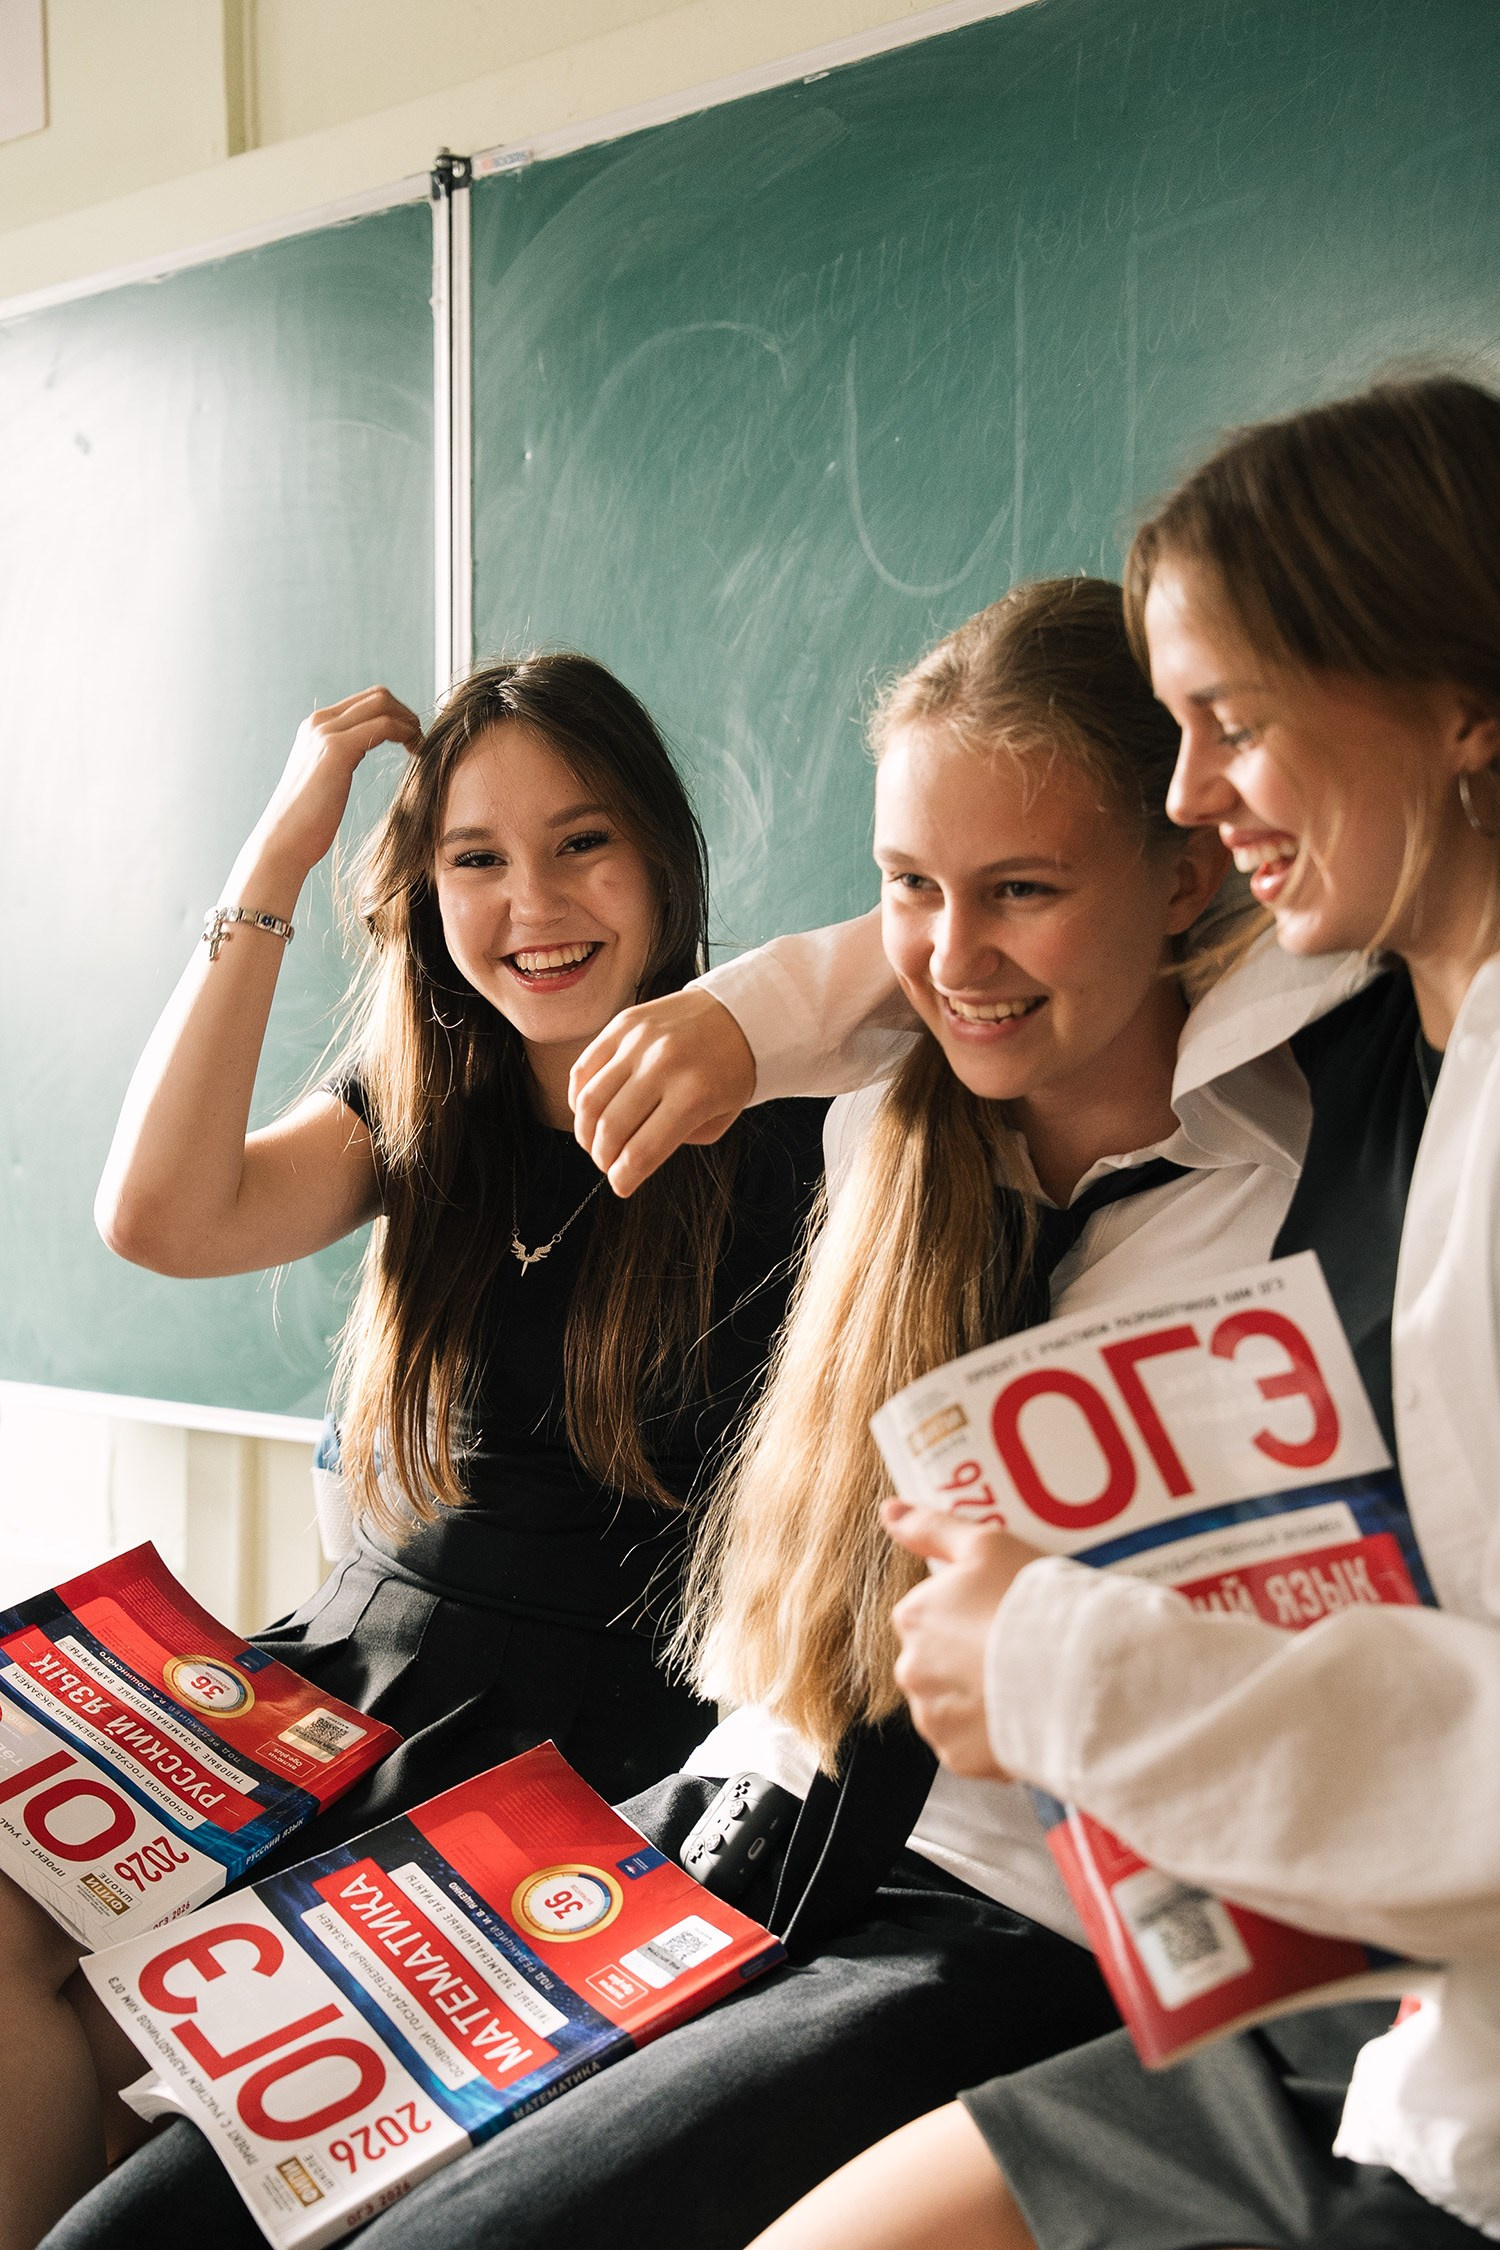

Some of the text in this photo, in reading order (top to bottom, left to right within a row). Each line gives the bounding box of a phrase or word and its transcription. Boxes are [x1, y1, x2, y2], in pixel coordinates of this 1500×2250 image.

[992, 1310, 1339, 1530] ОГЭ
[27, 1652, 112, 1716] ЯЗЫК
[69, 1646, 115, 1684] ВАРИАНТЫ
[98, 1650, 151, 1691] ДОЩИНСКОГО
[10, 1671, 54, 1707] ЭКЗАМЕН
[188, 1674, 225, 1700] 36
[115, 1685, 201, 1751] ЭКЗАМЕНАЦИОННЫЕ
[167, 1705, 220, 1746] РЕДАКЦИЕЙ
[54, 1708, 144, 1778] ГОСУДАРСТВЕННЫЙ
[100, 1714, 226, 1809] РУССКИЙ
[220, 1747, 241, 1762] ПОД
[201, 1752, 244, 1784] ТИПОВЫЕ
[143, 1779, 194, 1821] ОСНОВНОЙ
[0, 1816, 65, 1877] ПРОЕКТ С УЧАС
[114, 1836, 189, 1891] 2026
[85, 1876, 124, 1911] ФИПИ
[98, 1871, 133, 1903] ШКОЛЕ
[405, 1873, 445, 1912] ВАРИАНТЫ
[447, 1880, 479, 1909] ЯЩЕНКО
[542, 1887, 585, 1921] 36
[170, 1900, 191, 1919] 2026
[442, 1913, 516, 1989] ЭКЗАМЕНАЦИОННЫЕ
[488, 1924, 538, 1973] РЕДАКЦИЕЙ
[333, 1872, 534, 2075] МАТЕМАТИКА
[533, 1971, 555, 1990] ПОД
[315, 1912, 465, 2078] ОСНОВНОЙ ГОСУДАРСТВЕННЫЙ ЭКЗАМЕН
[513, 1989, 551, 2024] ТИПОВЫЕ
[139, 1924, 385, 2141] ОГЭ
[106, 1976, 259, 2166] ПРОЕКТ С УЧАСТИЕМ РАЗРАБОТЧИКОВ КИМ ОГЭ
[330, 2103, 430, 2172] 2026
